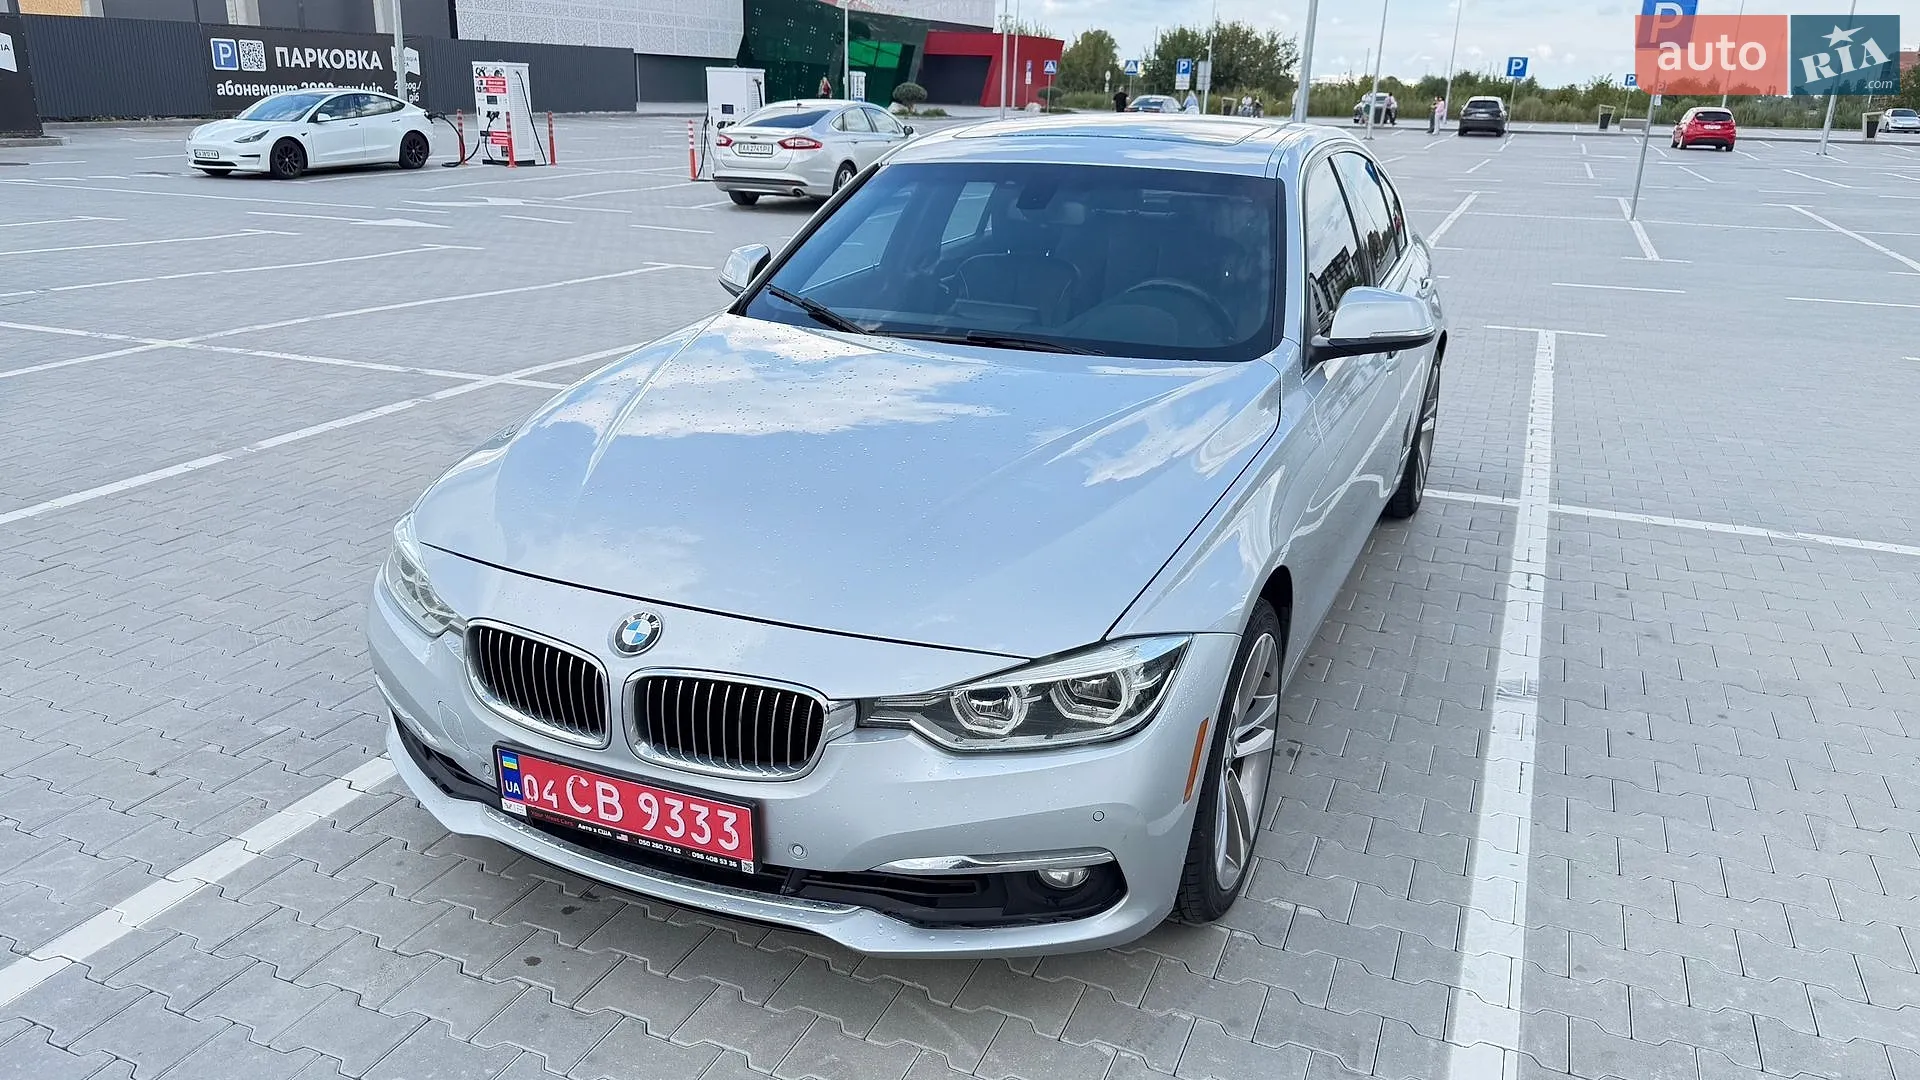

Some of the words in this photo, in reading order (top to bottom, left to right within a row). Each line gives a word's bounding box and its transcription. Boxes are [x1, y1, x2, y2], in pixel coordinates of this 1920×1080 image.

[275, 47, 384, 71] ПАРКОВКА
[505, 780, 521, 794] UA
[637, 792, 740, 851] 9333
